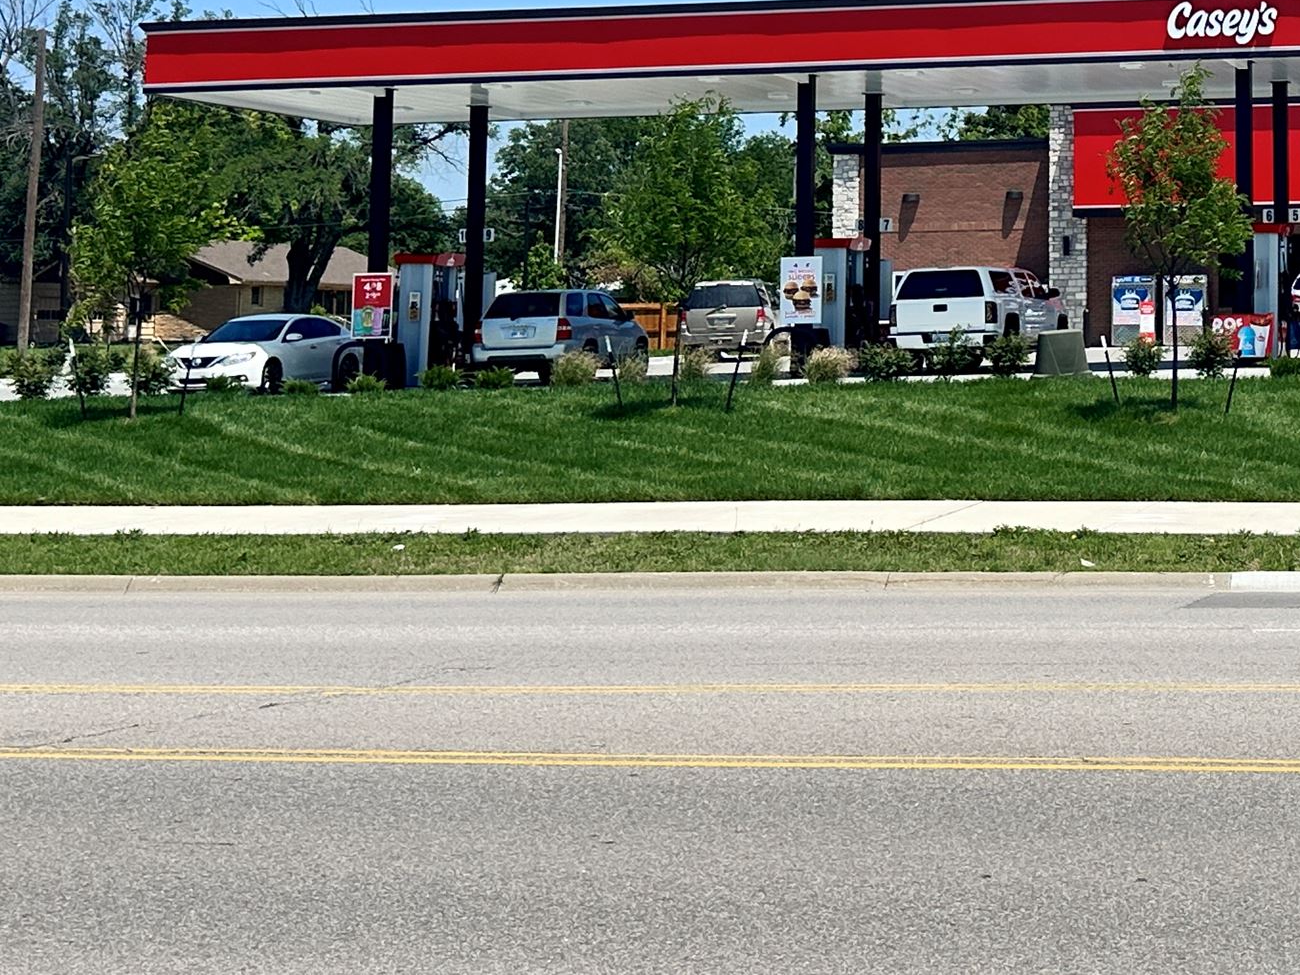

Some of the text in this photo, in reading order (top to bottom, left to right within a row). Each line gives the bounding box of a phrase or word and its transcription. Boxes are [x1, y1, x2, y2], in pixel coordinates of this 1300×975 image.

[1166, 0, 1278, 45] Casey's
[1265, 210, 1272, 222] 6
[1292, 210, 1299, 222] 5
[883, 219, 890, 231] 7
